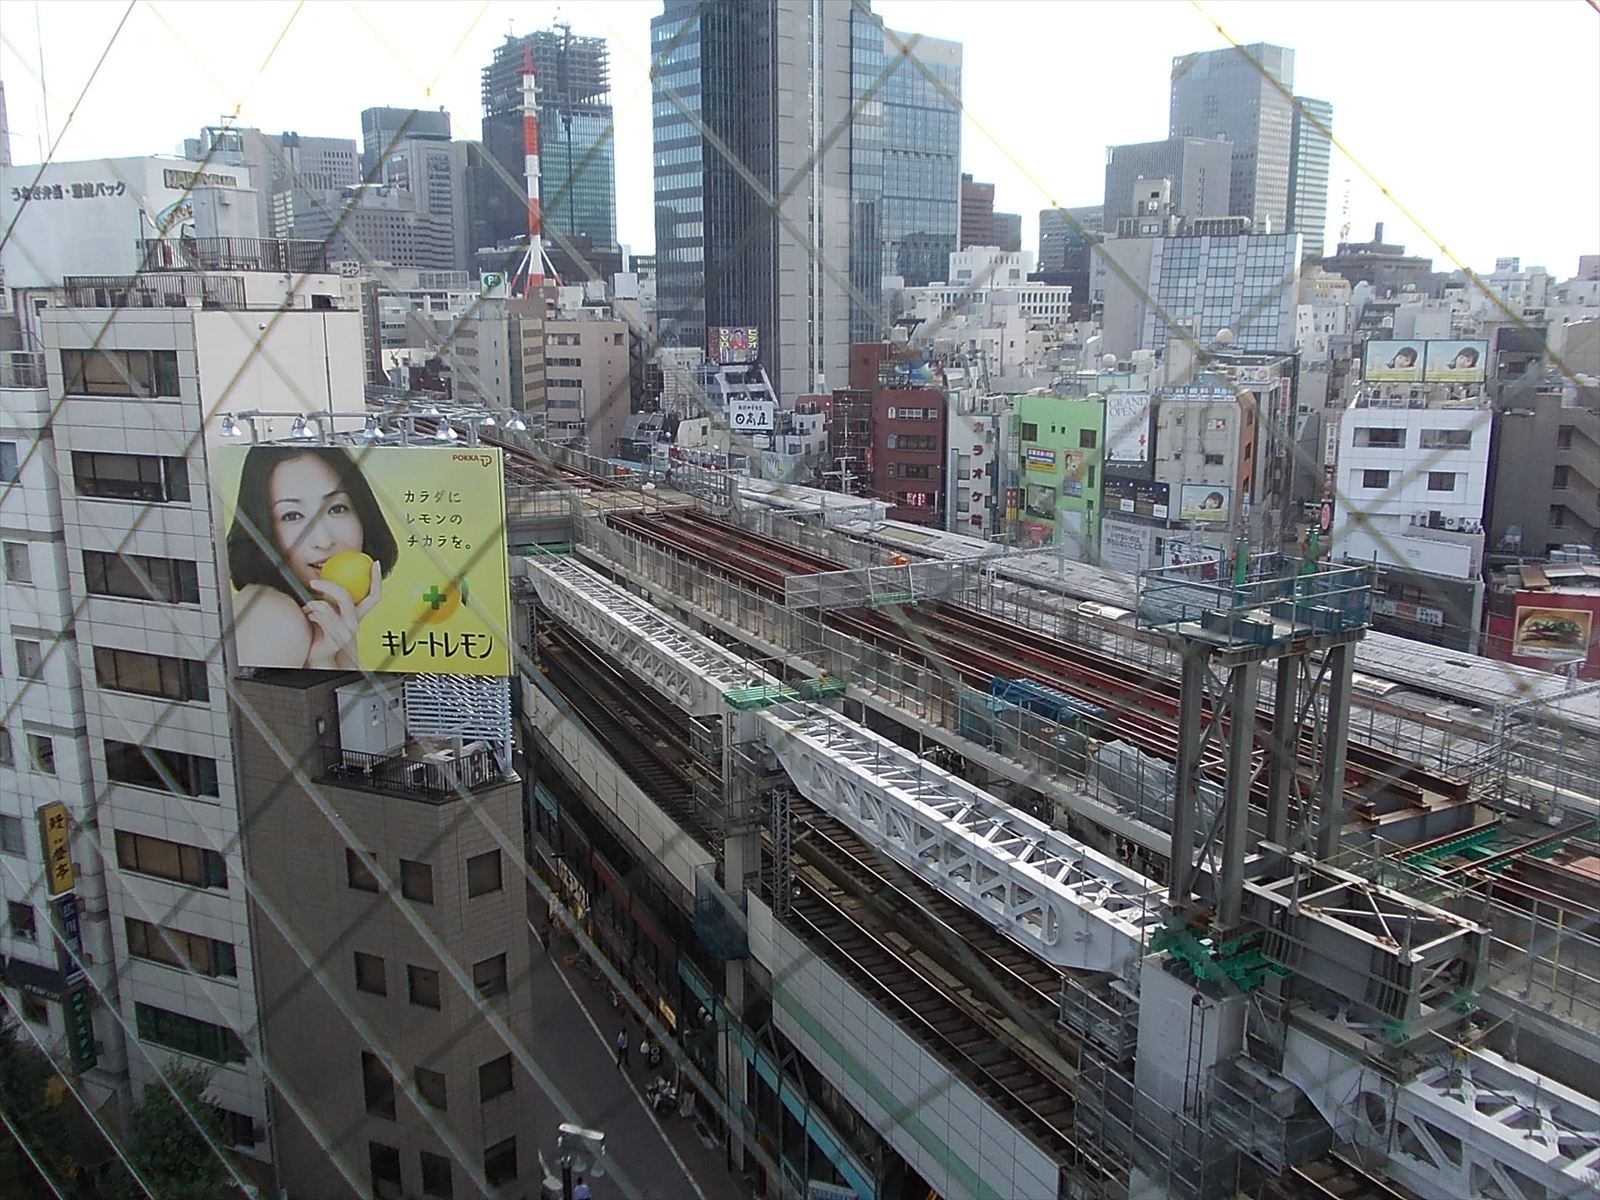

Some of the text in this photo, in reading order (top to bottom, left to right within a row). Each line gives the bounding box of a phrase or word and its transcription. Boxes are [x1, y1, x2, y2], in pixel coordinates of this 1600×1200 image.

[1109, 396, 1149, 407] GRAND
[1110, 407, 1137, 417] OPEN
[404, 489, 463, 504] カラダに
[406, 512, 464, 526] レモンの
[407, 534, 472, 550] チカラを。
[381, 630, 494, 660] キレートレモン
